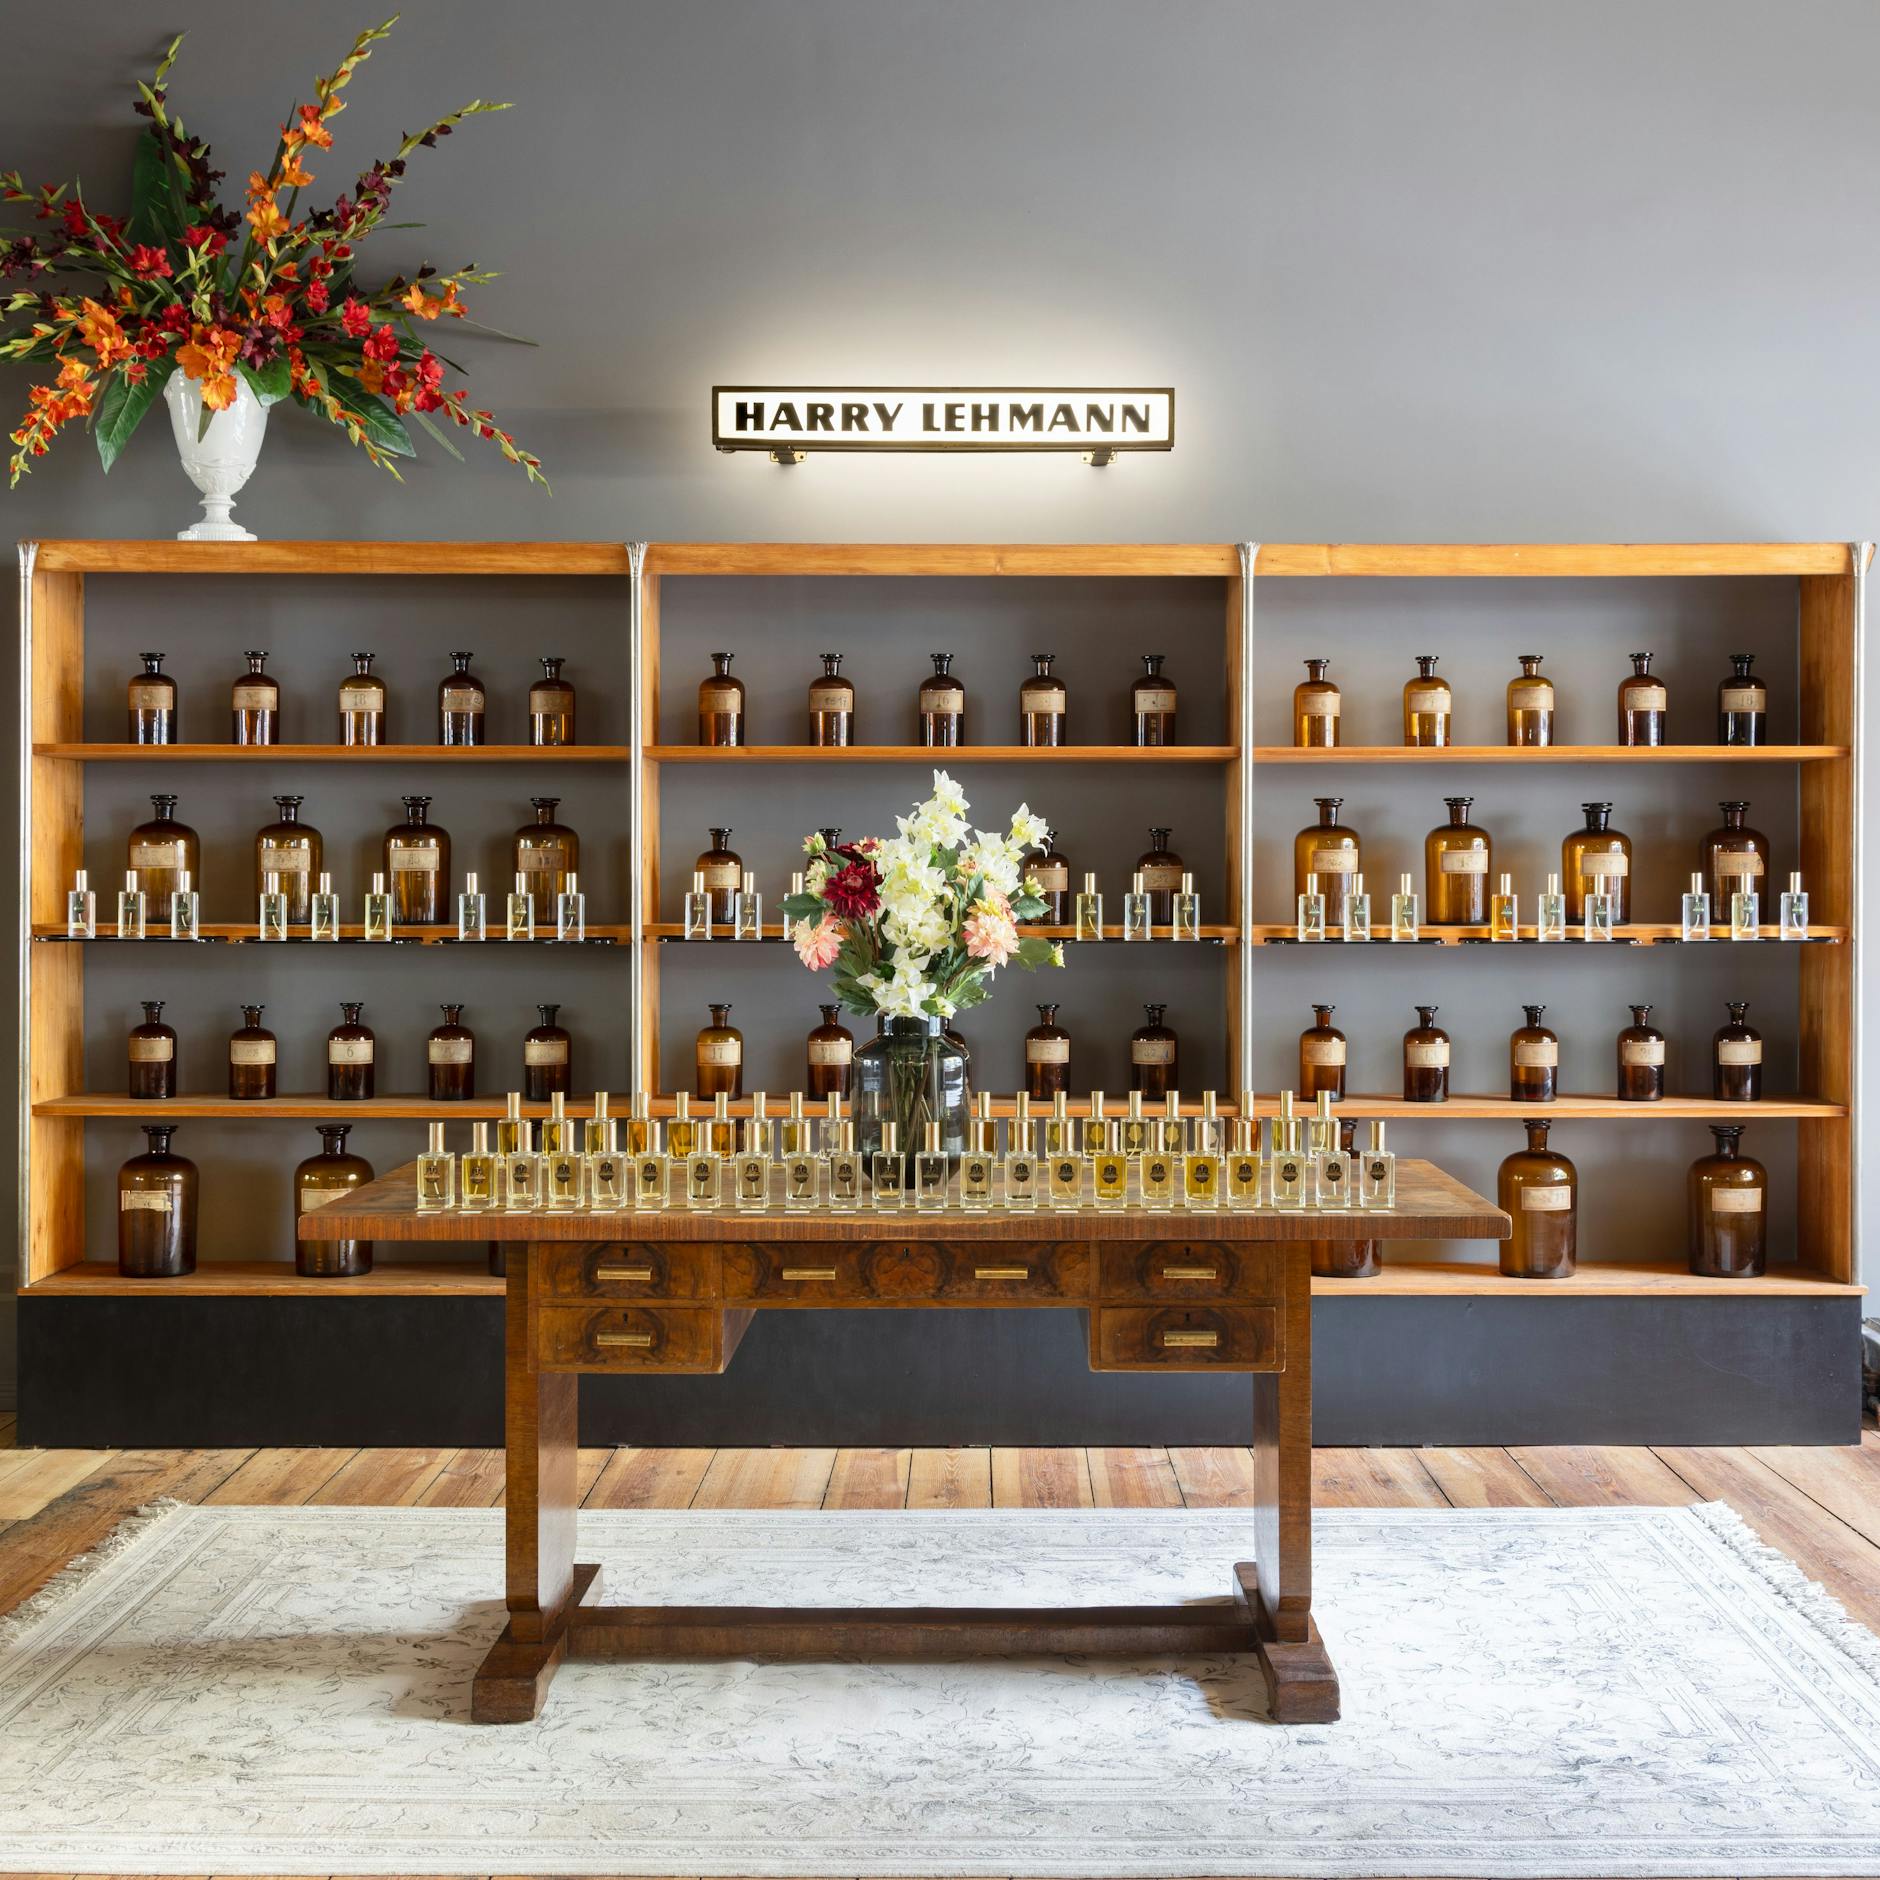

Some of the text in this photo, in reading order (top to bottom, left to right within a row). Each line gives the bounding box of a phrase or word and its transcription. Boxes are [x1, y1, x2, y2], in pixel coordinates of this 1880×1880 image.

[736, 402, 1149, 432] HARRY LEHMANN
[346, 1046, 354, 1057] 6
